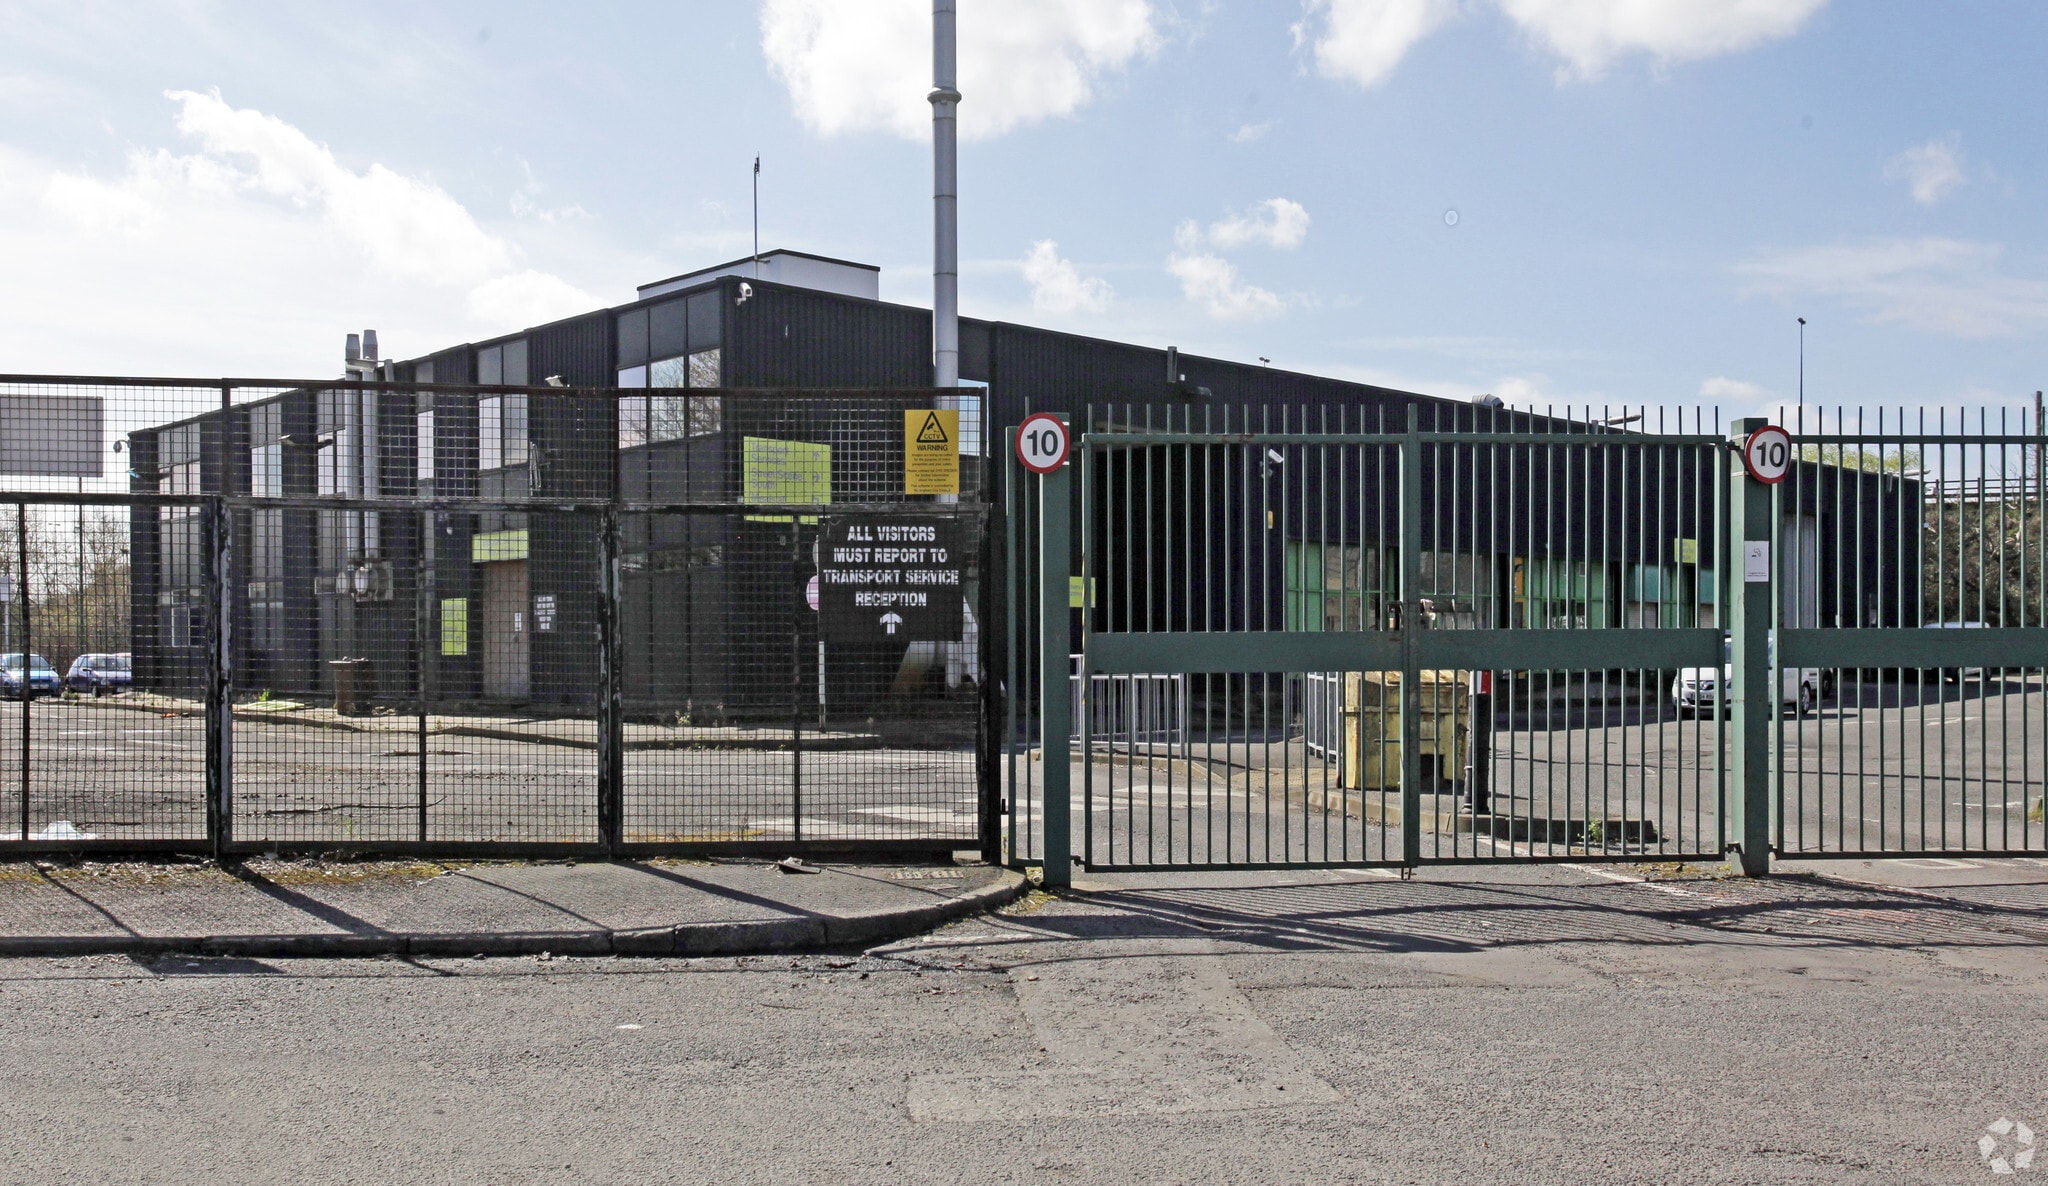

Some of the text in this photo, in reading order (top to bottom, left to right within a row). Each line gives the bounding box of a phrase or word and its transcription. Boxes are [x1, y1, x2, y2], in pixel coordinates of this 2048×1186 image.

[751, 442, 789, 455] Transport
[1027, 430, 1058, 456] 10
[1756, 441, 1785, 468] 10
[847, 526, 935, 542] ALL VISITORS
[834, 548, 948, 563] MUST REPORT TO
[823, 569, 959, 585] TRANSPORT SERVICE
[855, 591, 927, 606] RECEPTION
